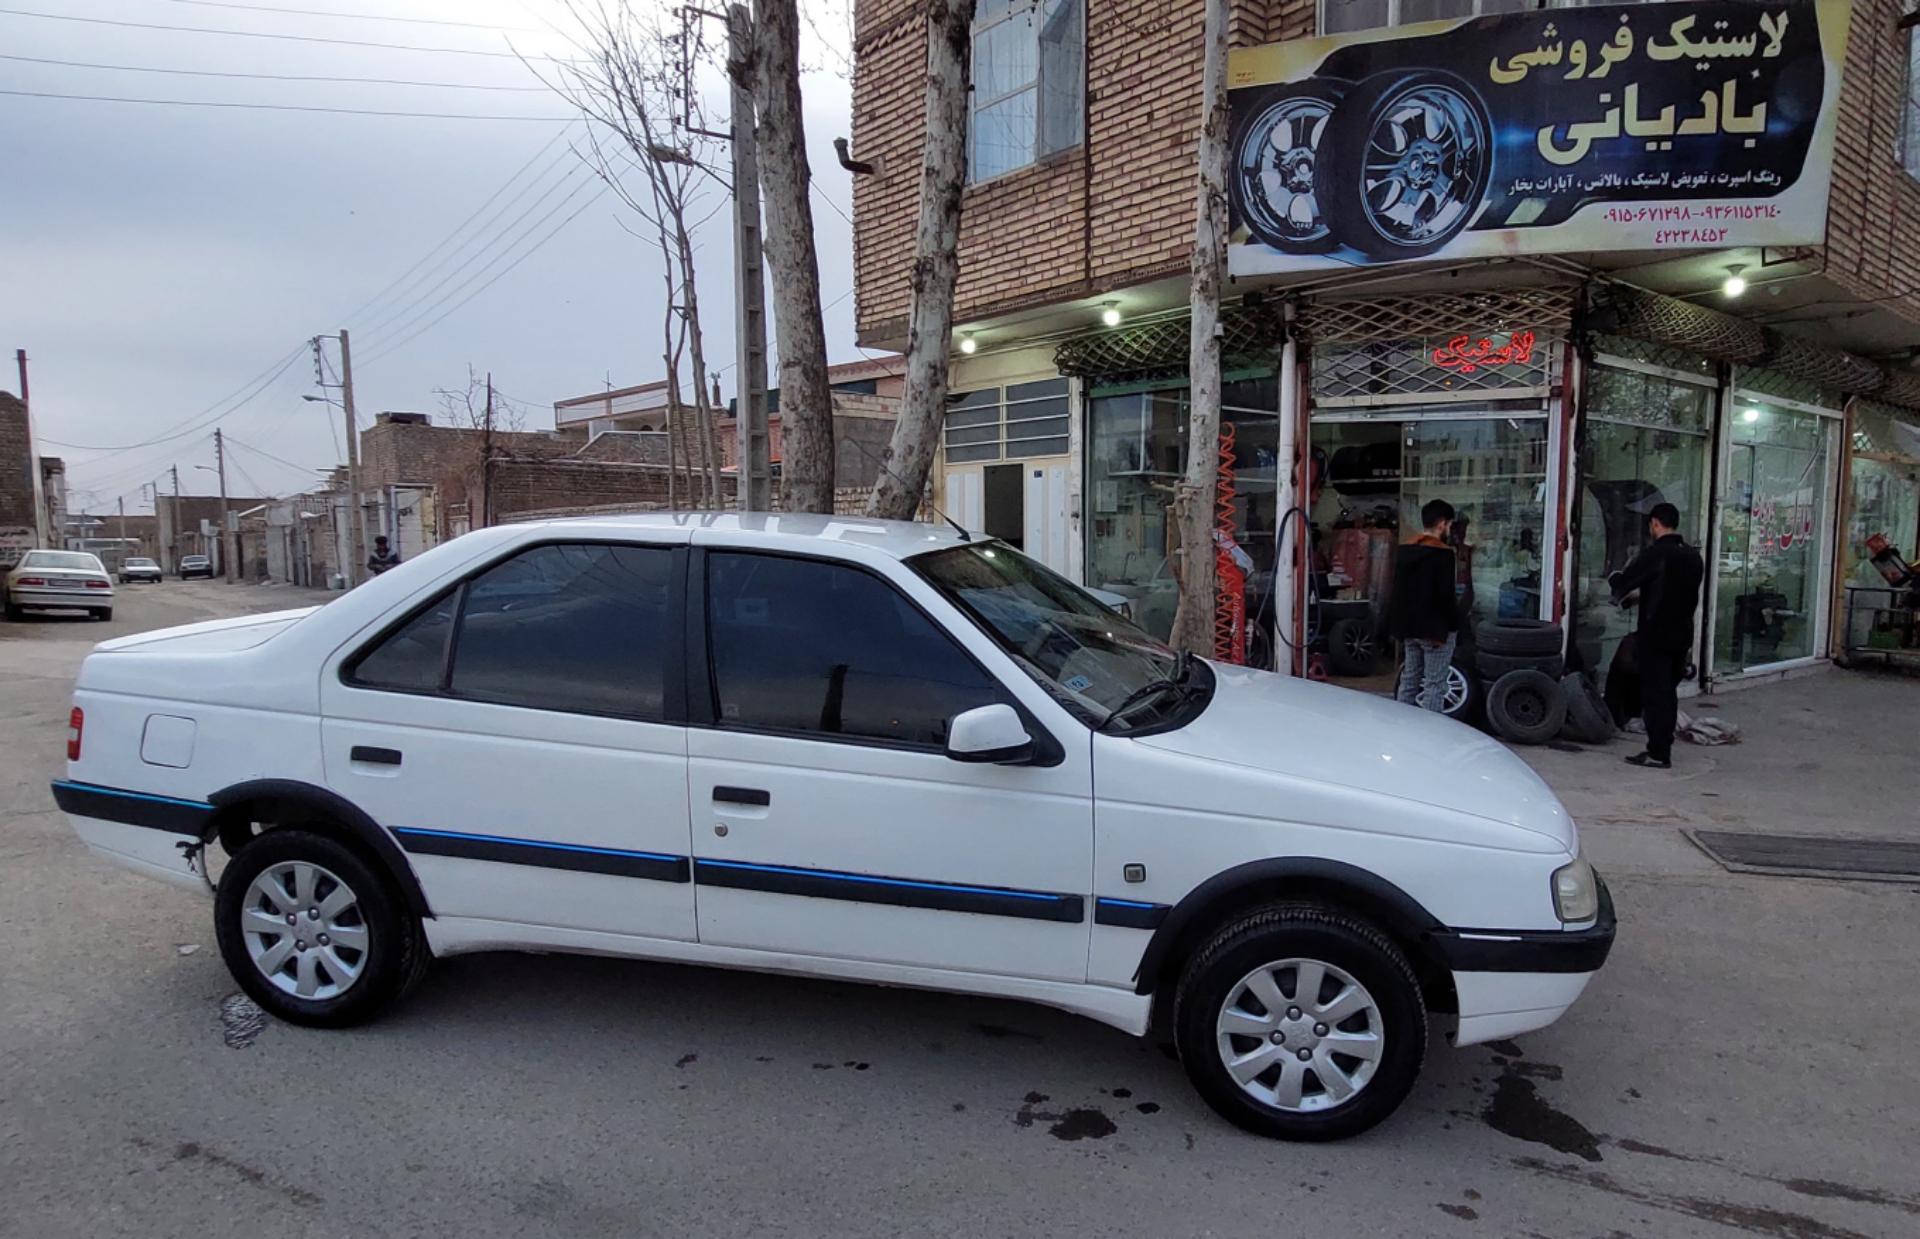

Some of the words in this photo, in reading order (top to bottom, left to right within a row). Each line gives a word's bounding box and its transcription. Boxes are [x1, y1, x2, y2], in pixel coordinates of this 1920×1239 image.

[1490, 13, 1634, 84] فروشی
[1646, 10, 1789, 70] لاستیک
[1537, 78, 1767, 165] بادیانی
[1508, 178, 1533, 195] بخار
[1671, 171, 1708, 188] تعویض
[1753, 170, 1781, 186] رینگ
[1432, 331, 1534, 374] لاستیک
